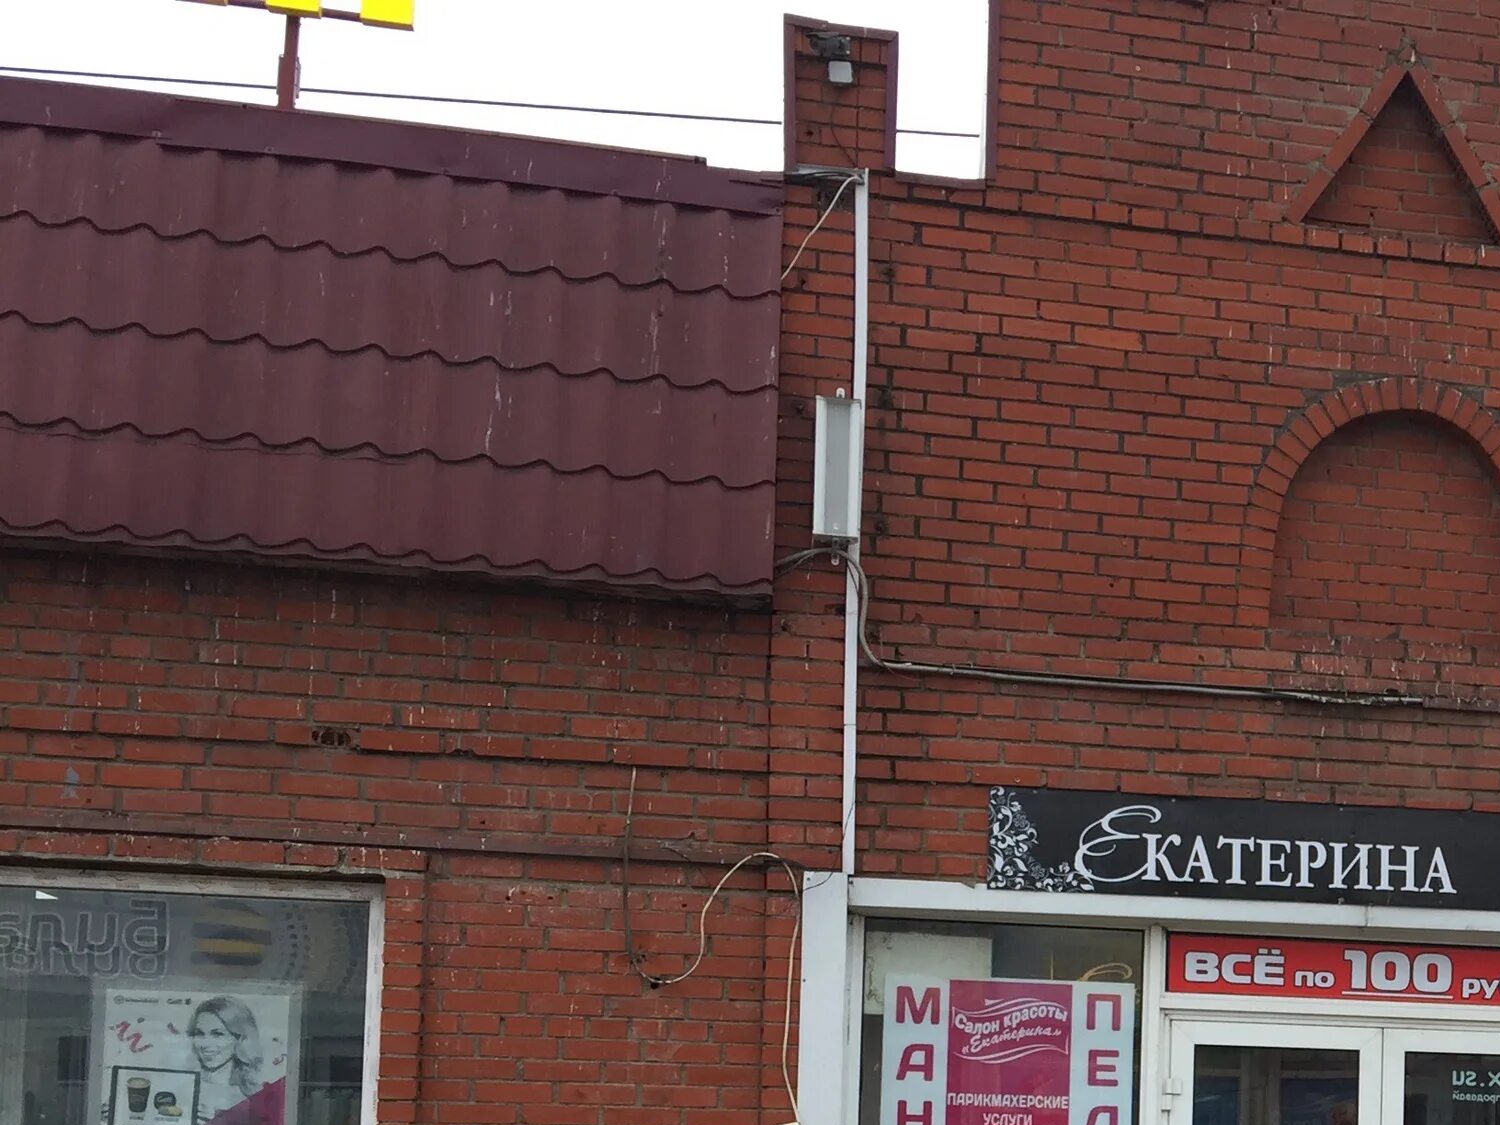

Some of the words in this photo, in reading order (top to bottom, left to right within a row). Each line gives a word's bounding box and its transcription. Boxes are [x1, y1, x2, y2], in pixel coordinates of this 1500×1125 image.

[1184, 948, 1286, 987] ВСЁ
[1294, 969, 1336, 988] по
[1343, 948, 1453, 994] 100
[954, 1014, 1000, 1037] Салон
[1003, 1004, 1068, 1029] красоты
[946, 1092, 1069, 1109] ПАРИКМАХЕРСКИЕ
